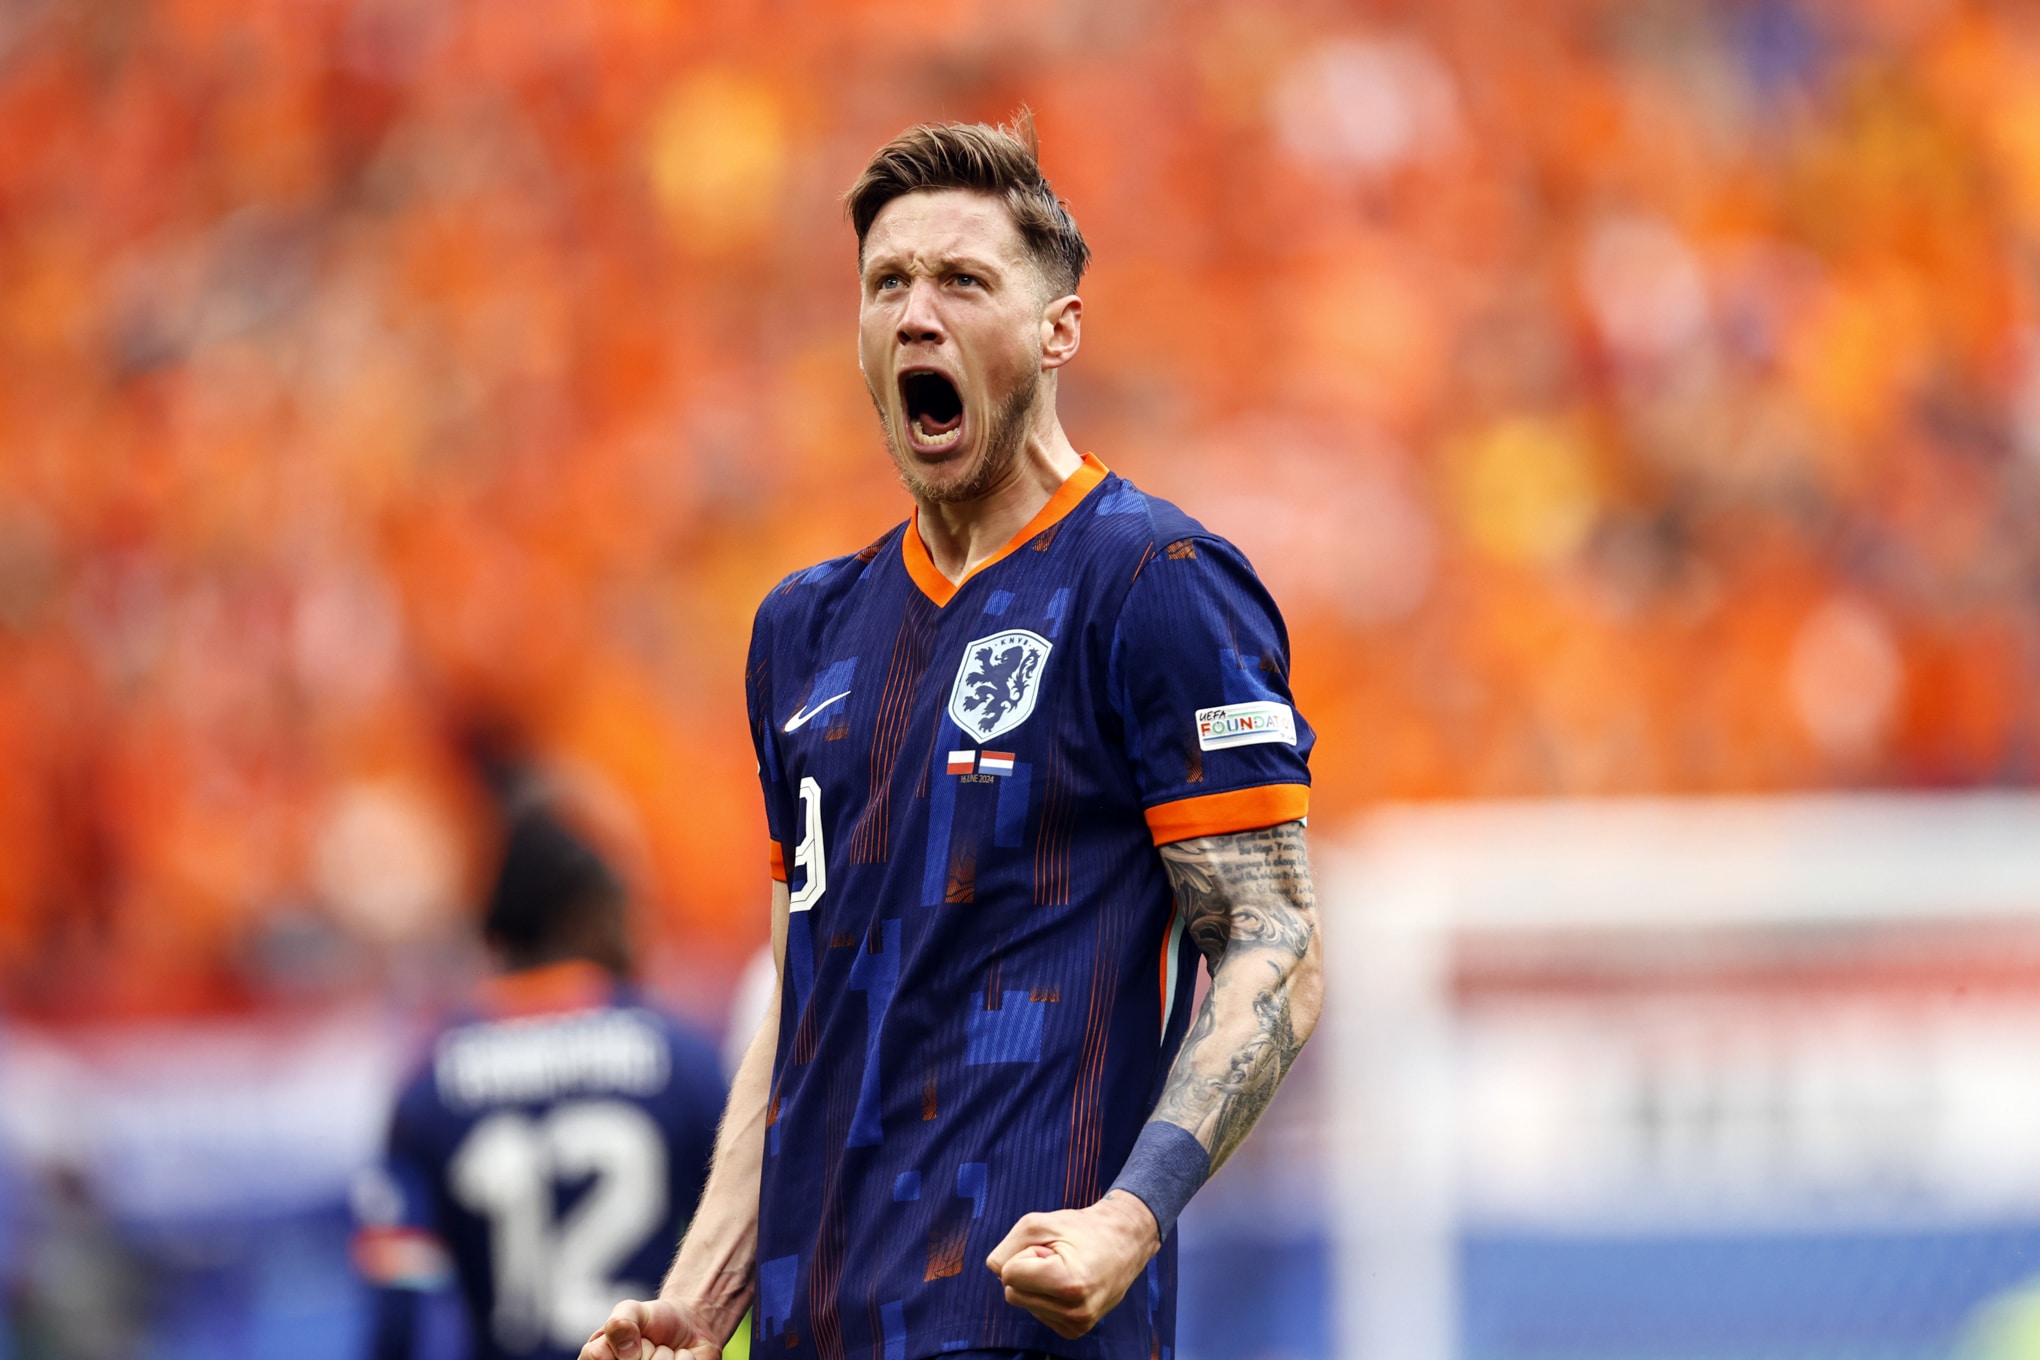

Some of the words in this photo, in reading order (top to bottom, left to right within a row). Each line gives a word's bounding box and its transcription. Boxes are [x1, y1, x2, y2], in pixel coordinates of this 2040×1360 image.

[1200, 710, 1227, 721] UEFA
[979, 775, 994, 784] 2024
[789, 776, 826, 913] 9
[451, 1098, 668, 1352] 12
